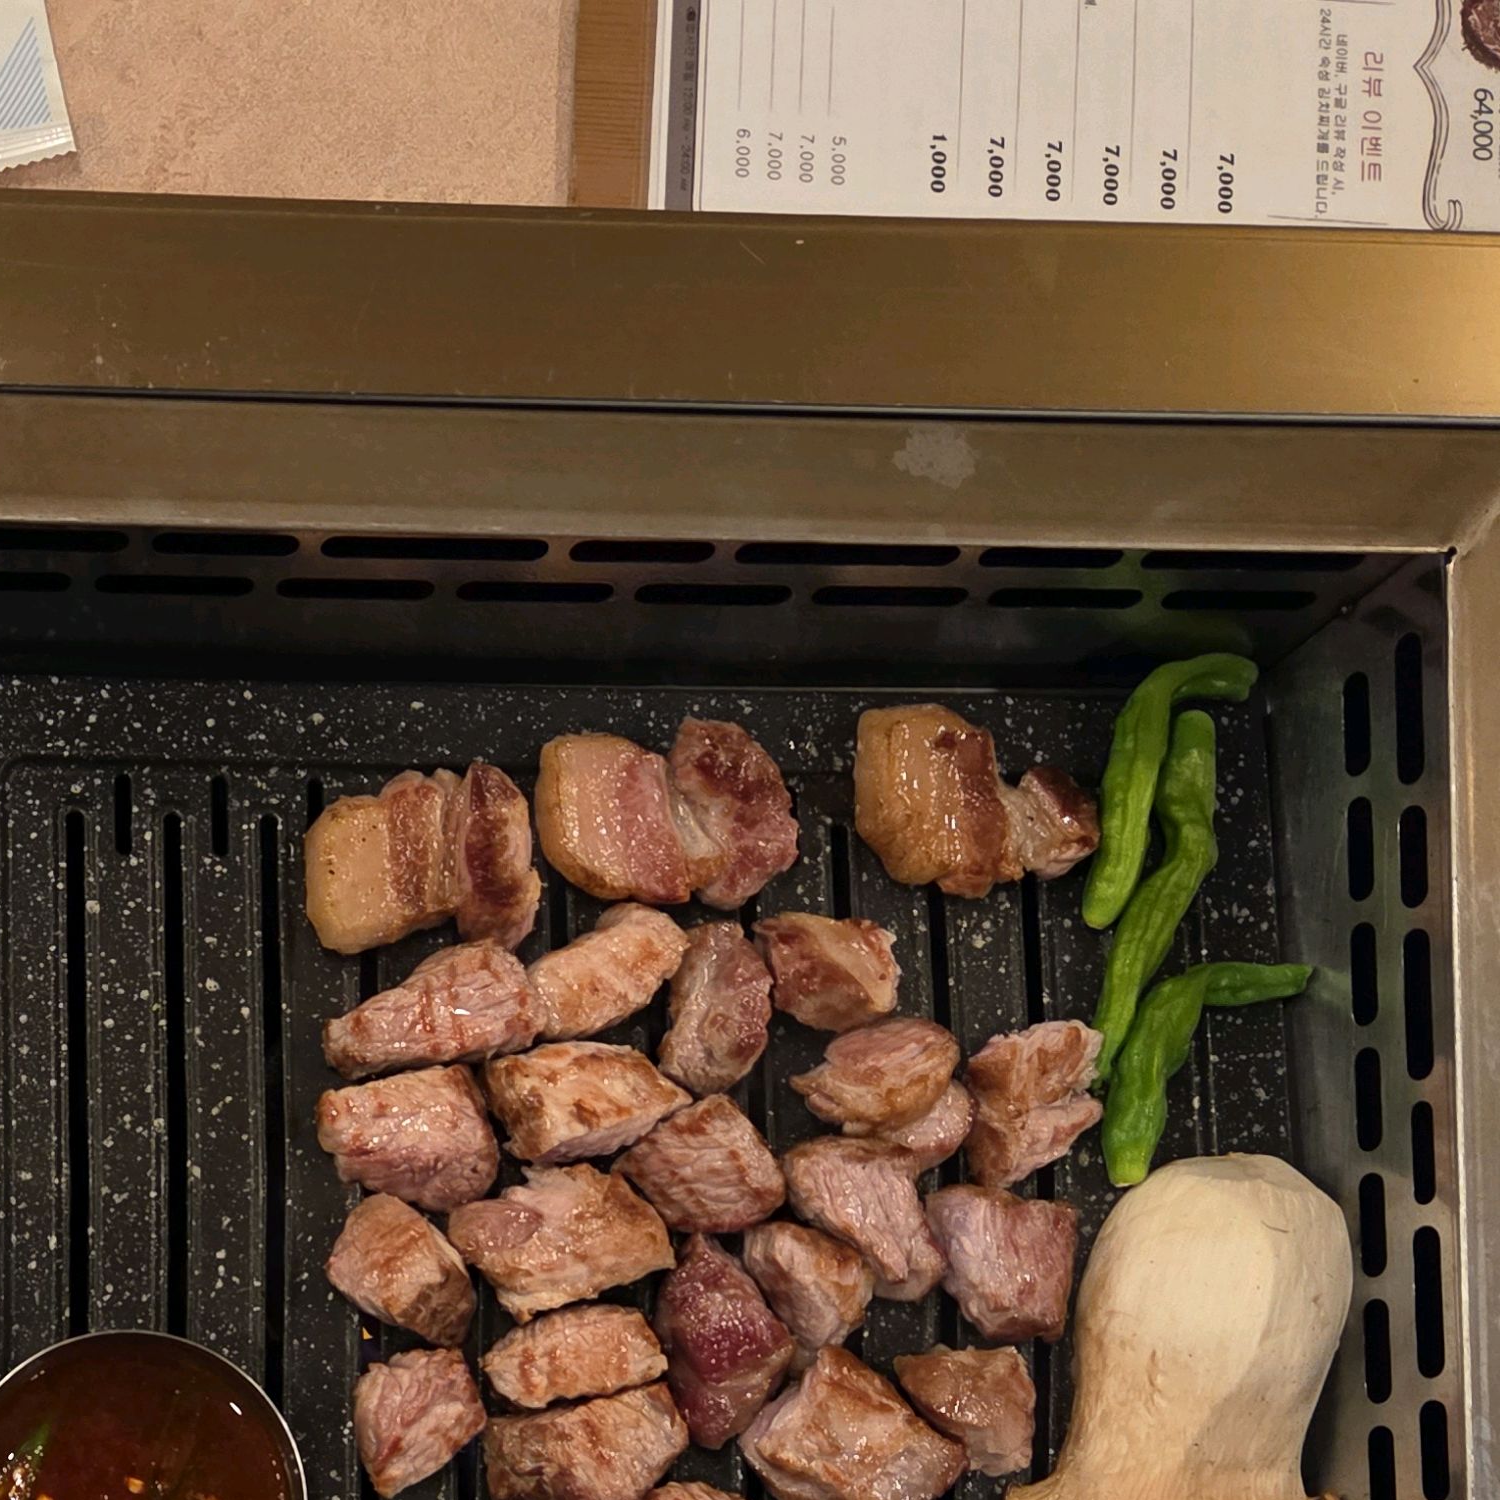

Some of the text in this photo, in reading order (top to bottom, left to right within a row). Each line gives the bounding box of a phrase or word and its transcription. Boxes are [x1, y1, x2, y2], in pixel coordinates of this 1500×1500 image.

[1315, 8, 1332, 218] 24시간 숙성 김치찌개를 드립니다.
[1334, 83, 1347, 109] 구글
[1361, 51, 1384, 181] 리뷰 이벤트
[1470, 88, 1494, 161] 64,000
[1334, 115, 1347, 141] 리뷰
[929, 134, 947, 193] 1,000
[987, 137, 1005, 197] 7,000
[1044, 141, 1062, 202] 7,000
[1102, 145, 1120, 206] 7,000
[1159, 149, 1177, 210] 7,000
[1217, 153, 1235, 214] 7,000
[1333, 146, 1346, 172] 작성
